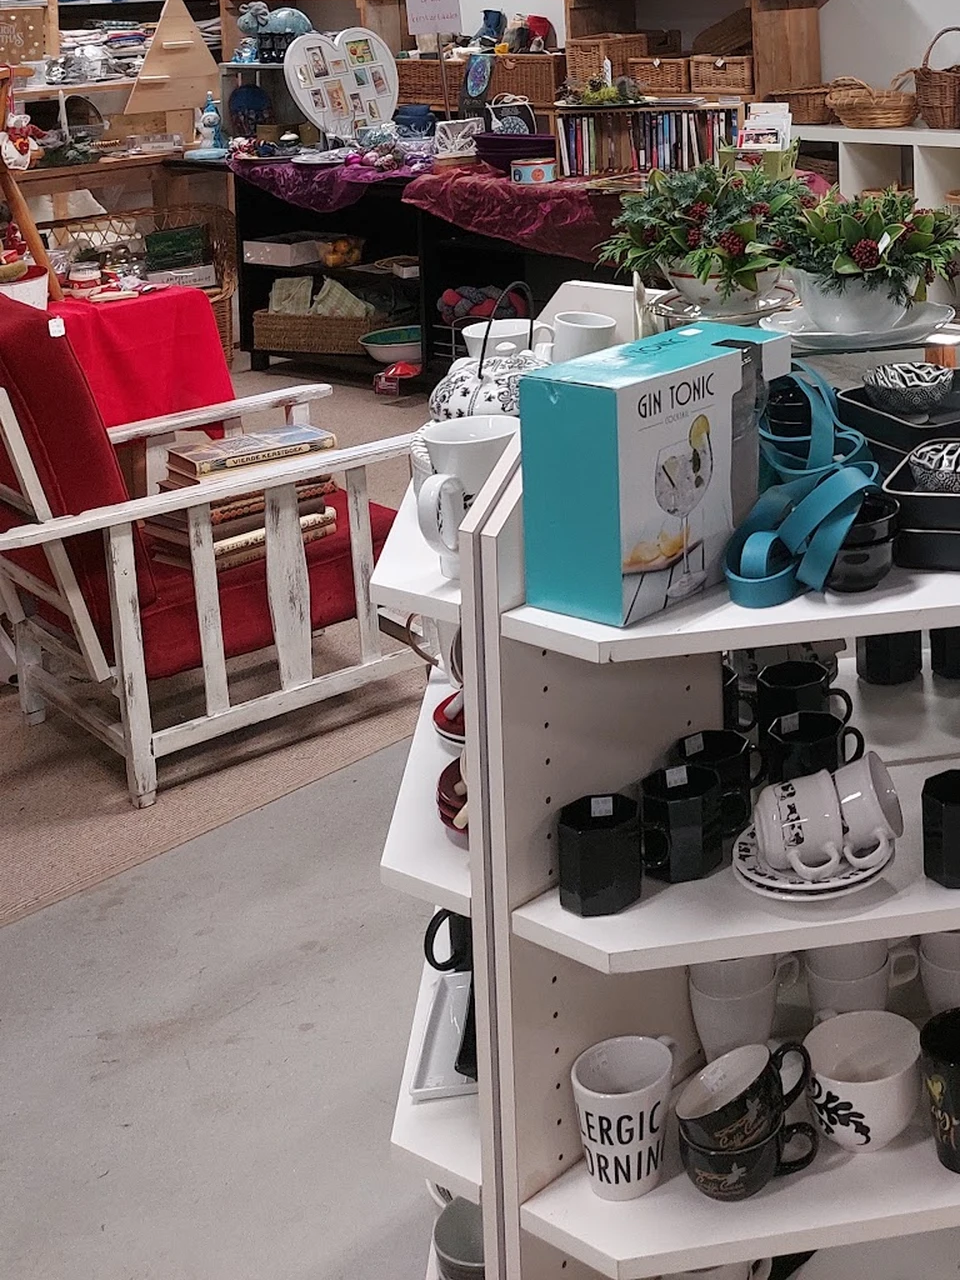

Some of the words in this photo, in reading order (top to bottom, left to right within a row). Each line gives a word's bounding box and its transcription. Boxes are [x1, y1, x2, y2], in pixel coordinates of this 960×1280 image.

[637, 389, 662, 419] GIN
[668, 372, 715, 410] TONIC
[231, 454, 261, 465] VIERDE
